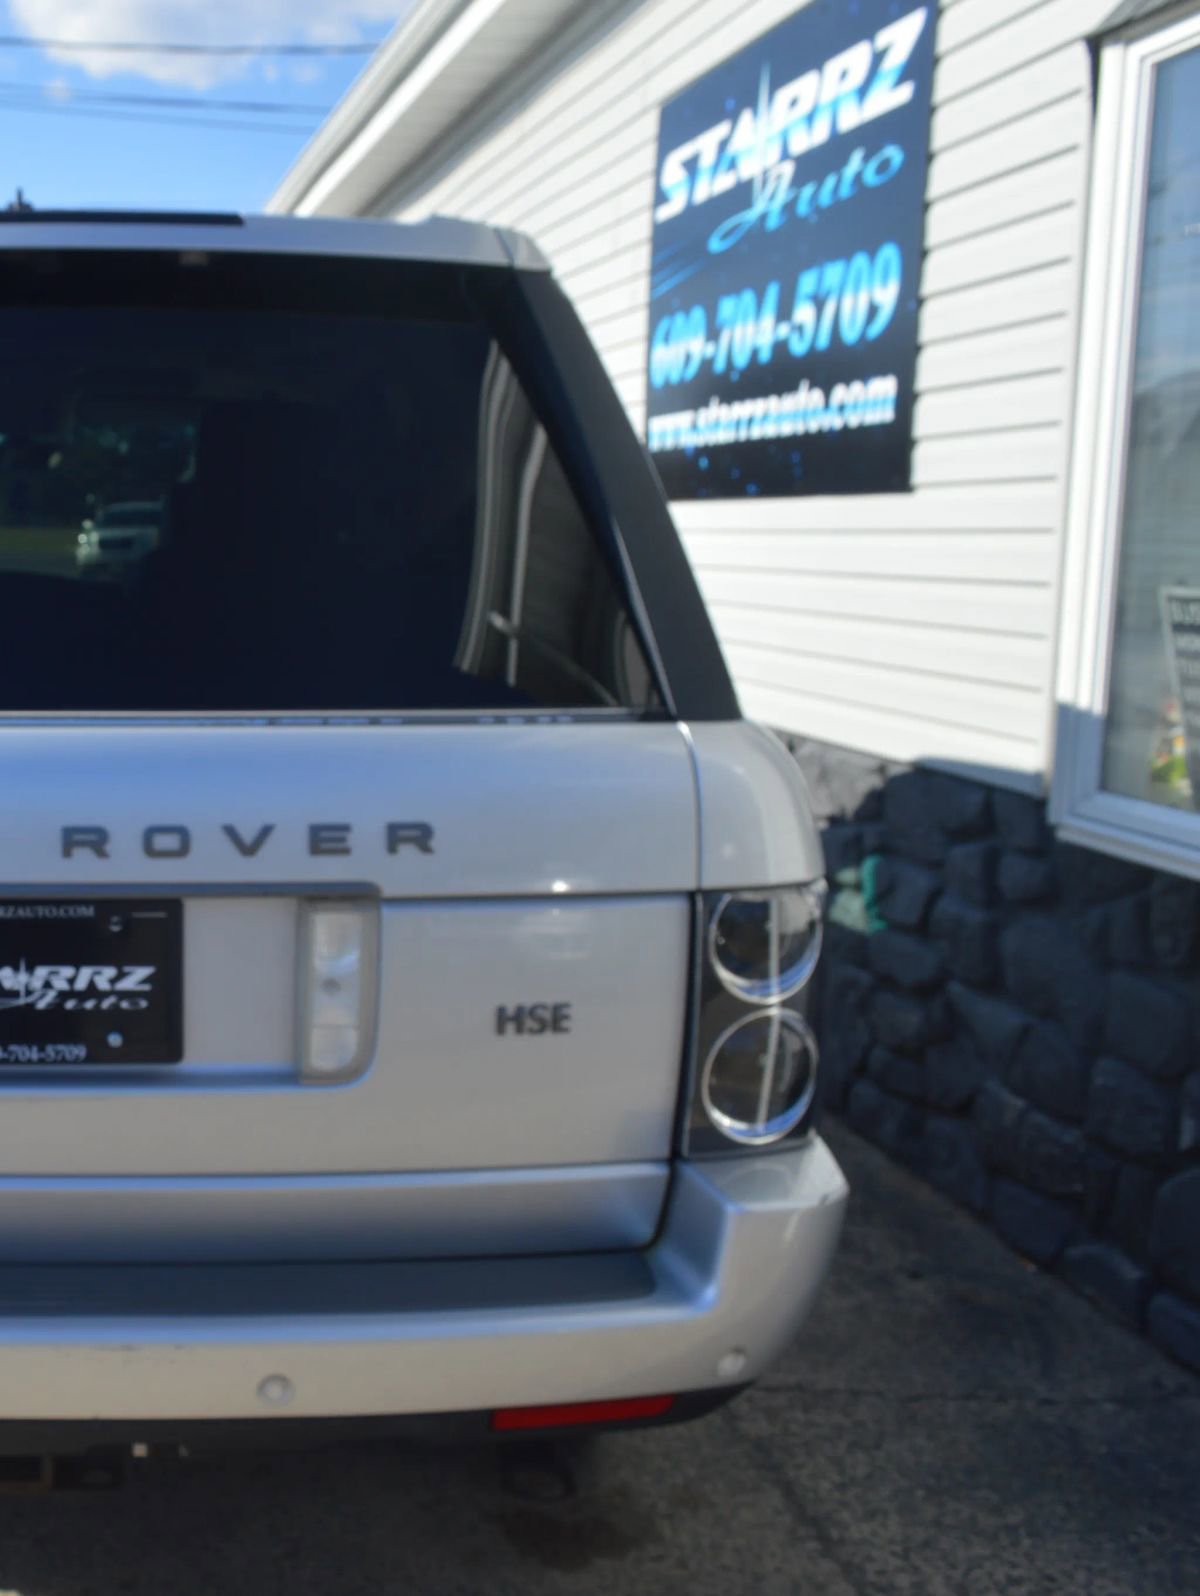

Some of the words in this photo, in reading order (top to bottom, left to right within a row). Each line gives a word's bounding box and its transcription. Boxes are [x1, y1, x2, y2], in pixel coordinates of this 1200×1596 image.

[655, 6, 928, 223] STARRZ
[707, 144, 904, 254] Auto
[650, 241, 902, 388] 609-704-5709
[61, 821, 435, 859] ROVER
[496, 1003, 572, 1035] HSE
